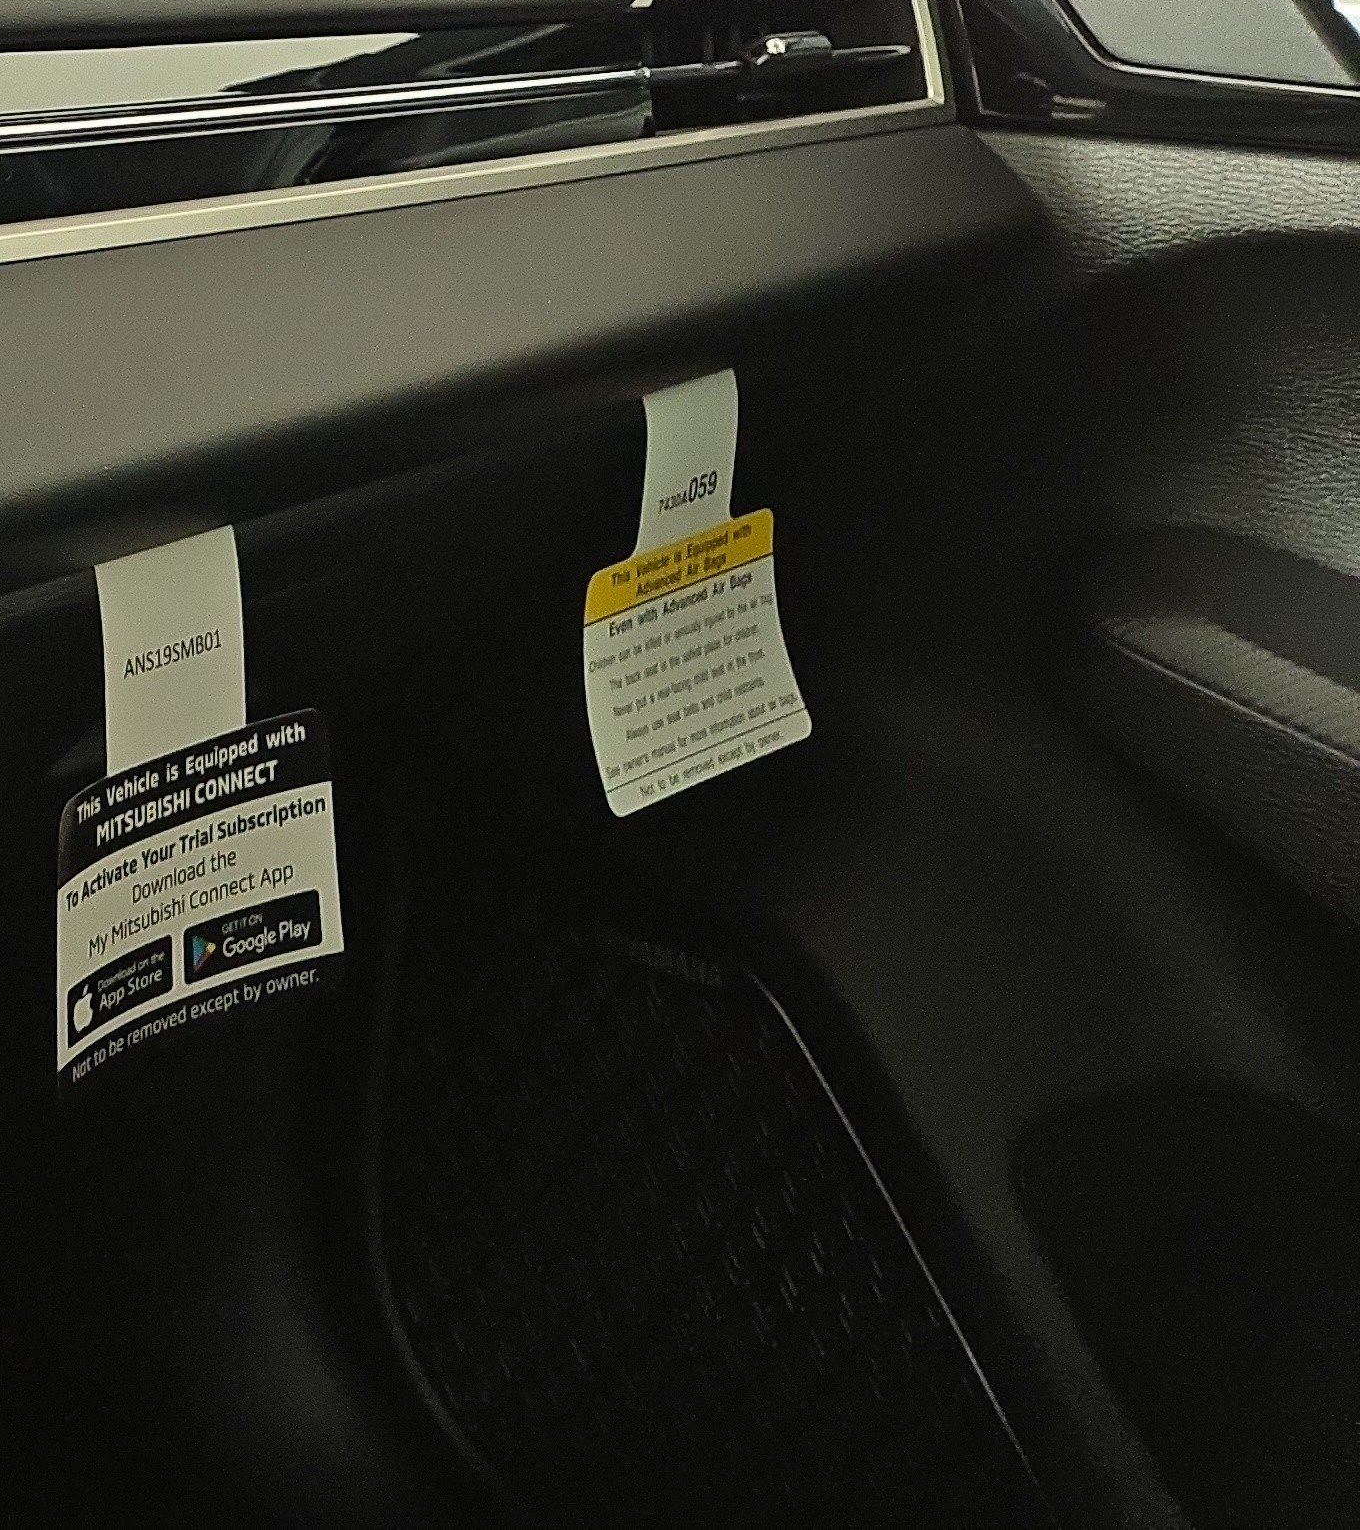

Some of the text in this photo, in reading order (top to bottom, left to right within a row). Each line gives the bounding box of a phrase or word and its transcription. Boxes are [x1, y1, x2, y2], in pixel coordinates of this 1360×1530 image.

[124, 628, 222, 680] ANS19SMB01
[77, 722, 306, 824] This Vehicle is Equipped with
[96, 760, 278, 847] MITSUBISHI CONNECT
[66, 797, 326, 912] To Activate Your Trial Subscription
[132, 850, 237, 904] Download the
[87, 864, 294, 958] My Mitsubishi Connect App
[222, 920, 312, 957] Google Play
[97, 951, 165, 993] Download on the
[99, 969, 163, 1010] App Store
[72, 969, 319, 1083] Not to be removed except by owner.
